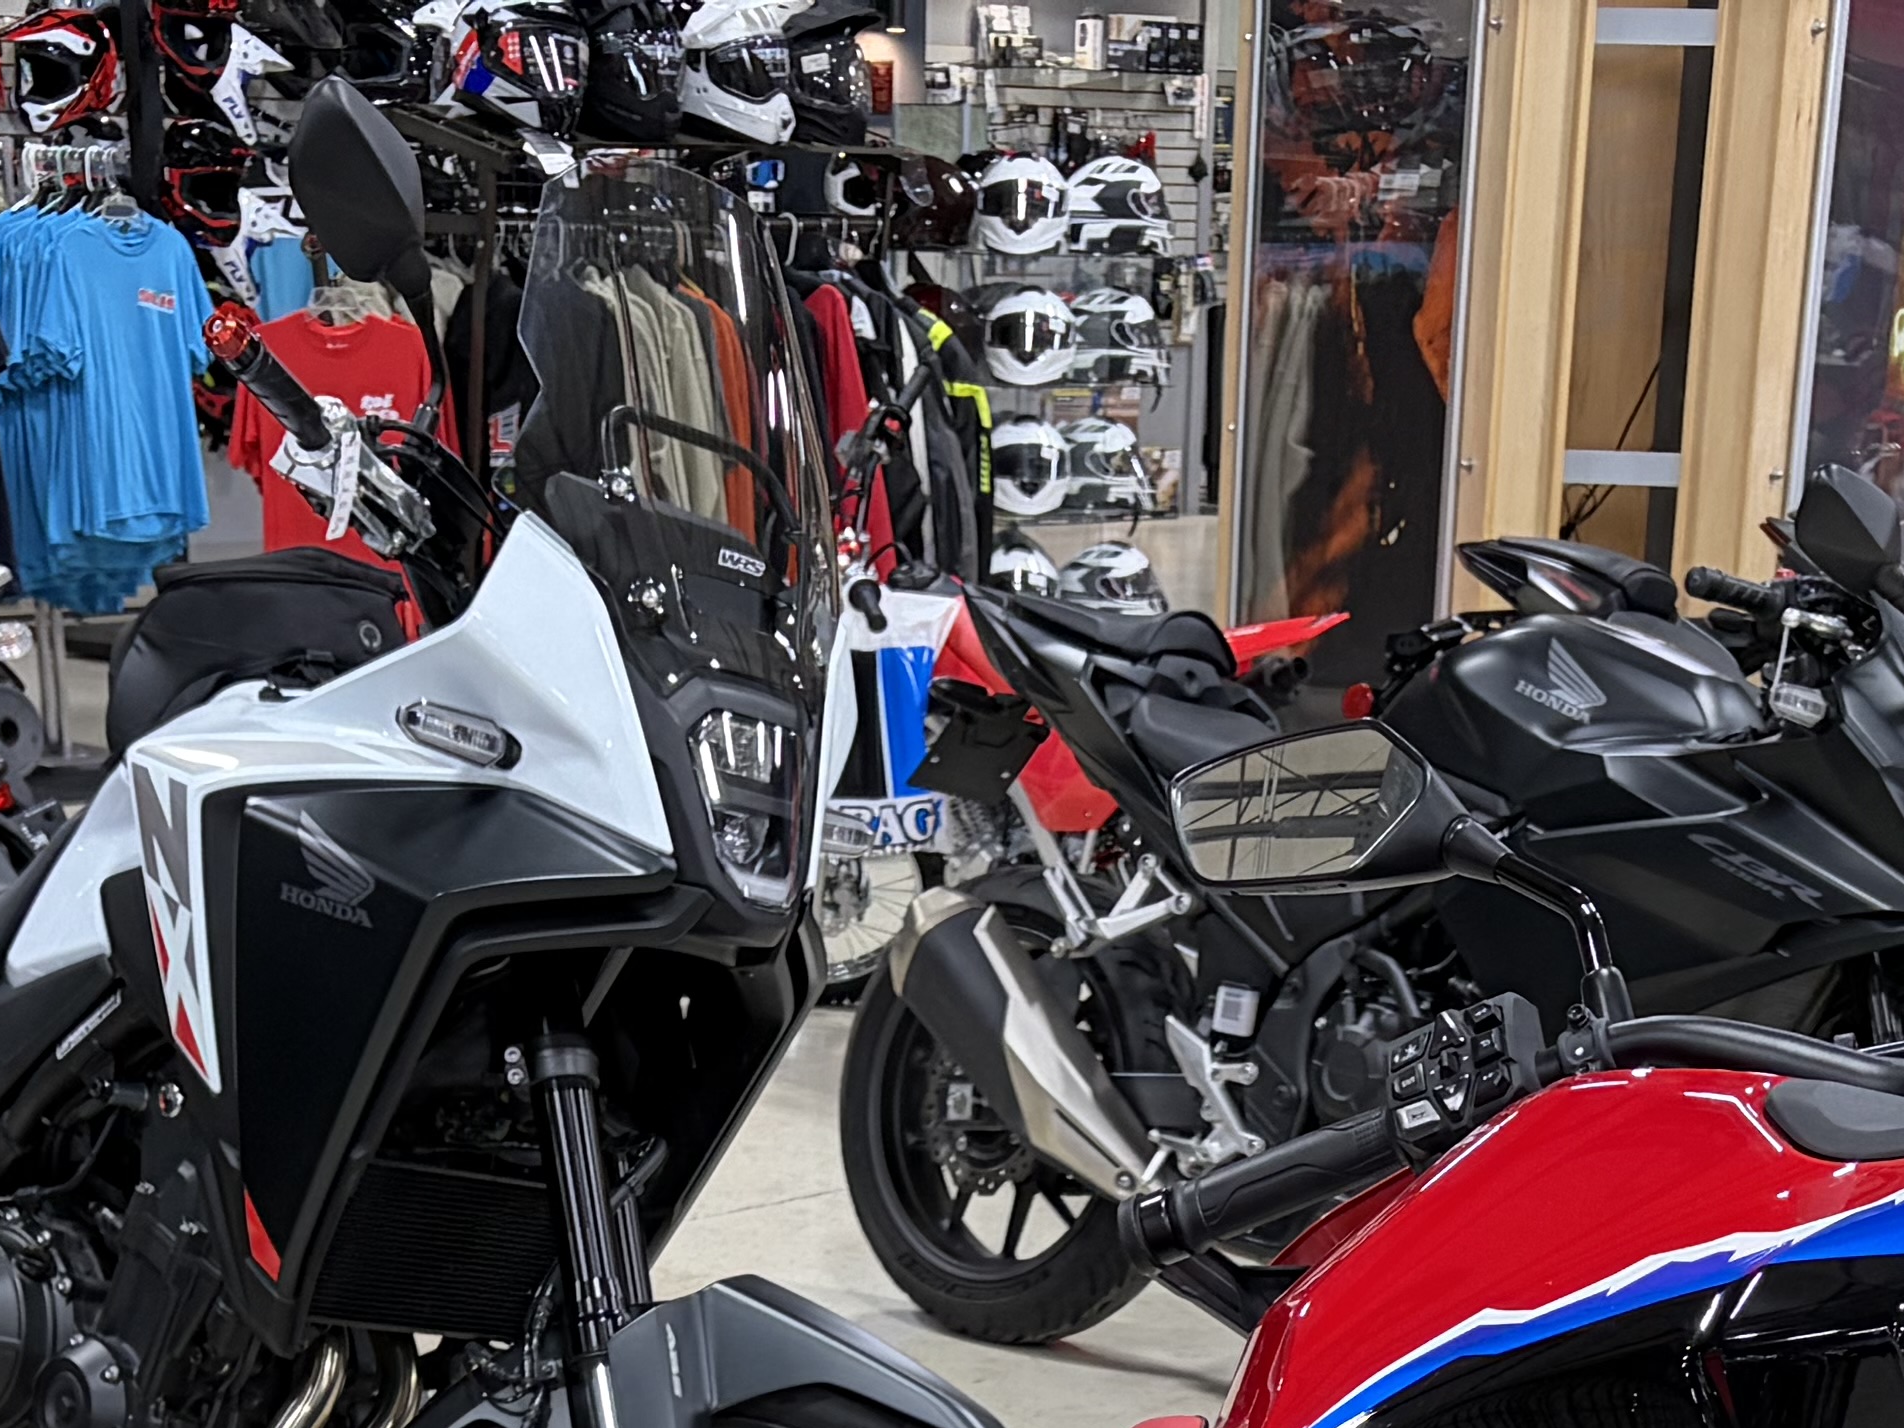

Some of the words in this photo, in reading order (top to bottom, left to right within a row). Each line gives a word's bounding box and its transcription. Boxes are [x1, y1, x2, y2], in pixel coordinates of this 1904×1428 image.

[223, 97, 245, 120] FLY
[224, 260, 245, 284] FLY
[1515, 680, 1590, 725] HONDA
[1687, 833, 1824, 911] CBR
[280, 882, 374, 928] HONDA
